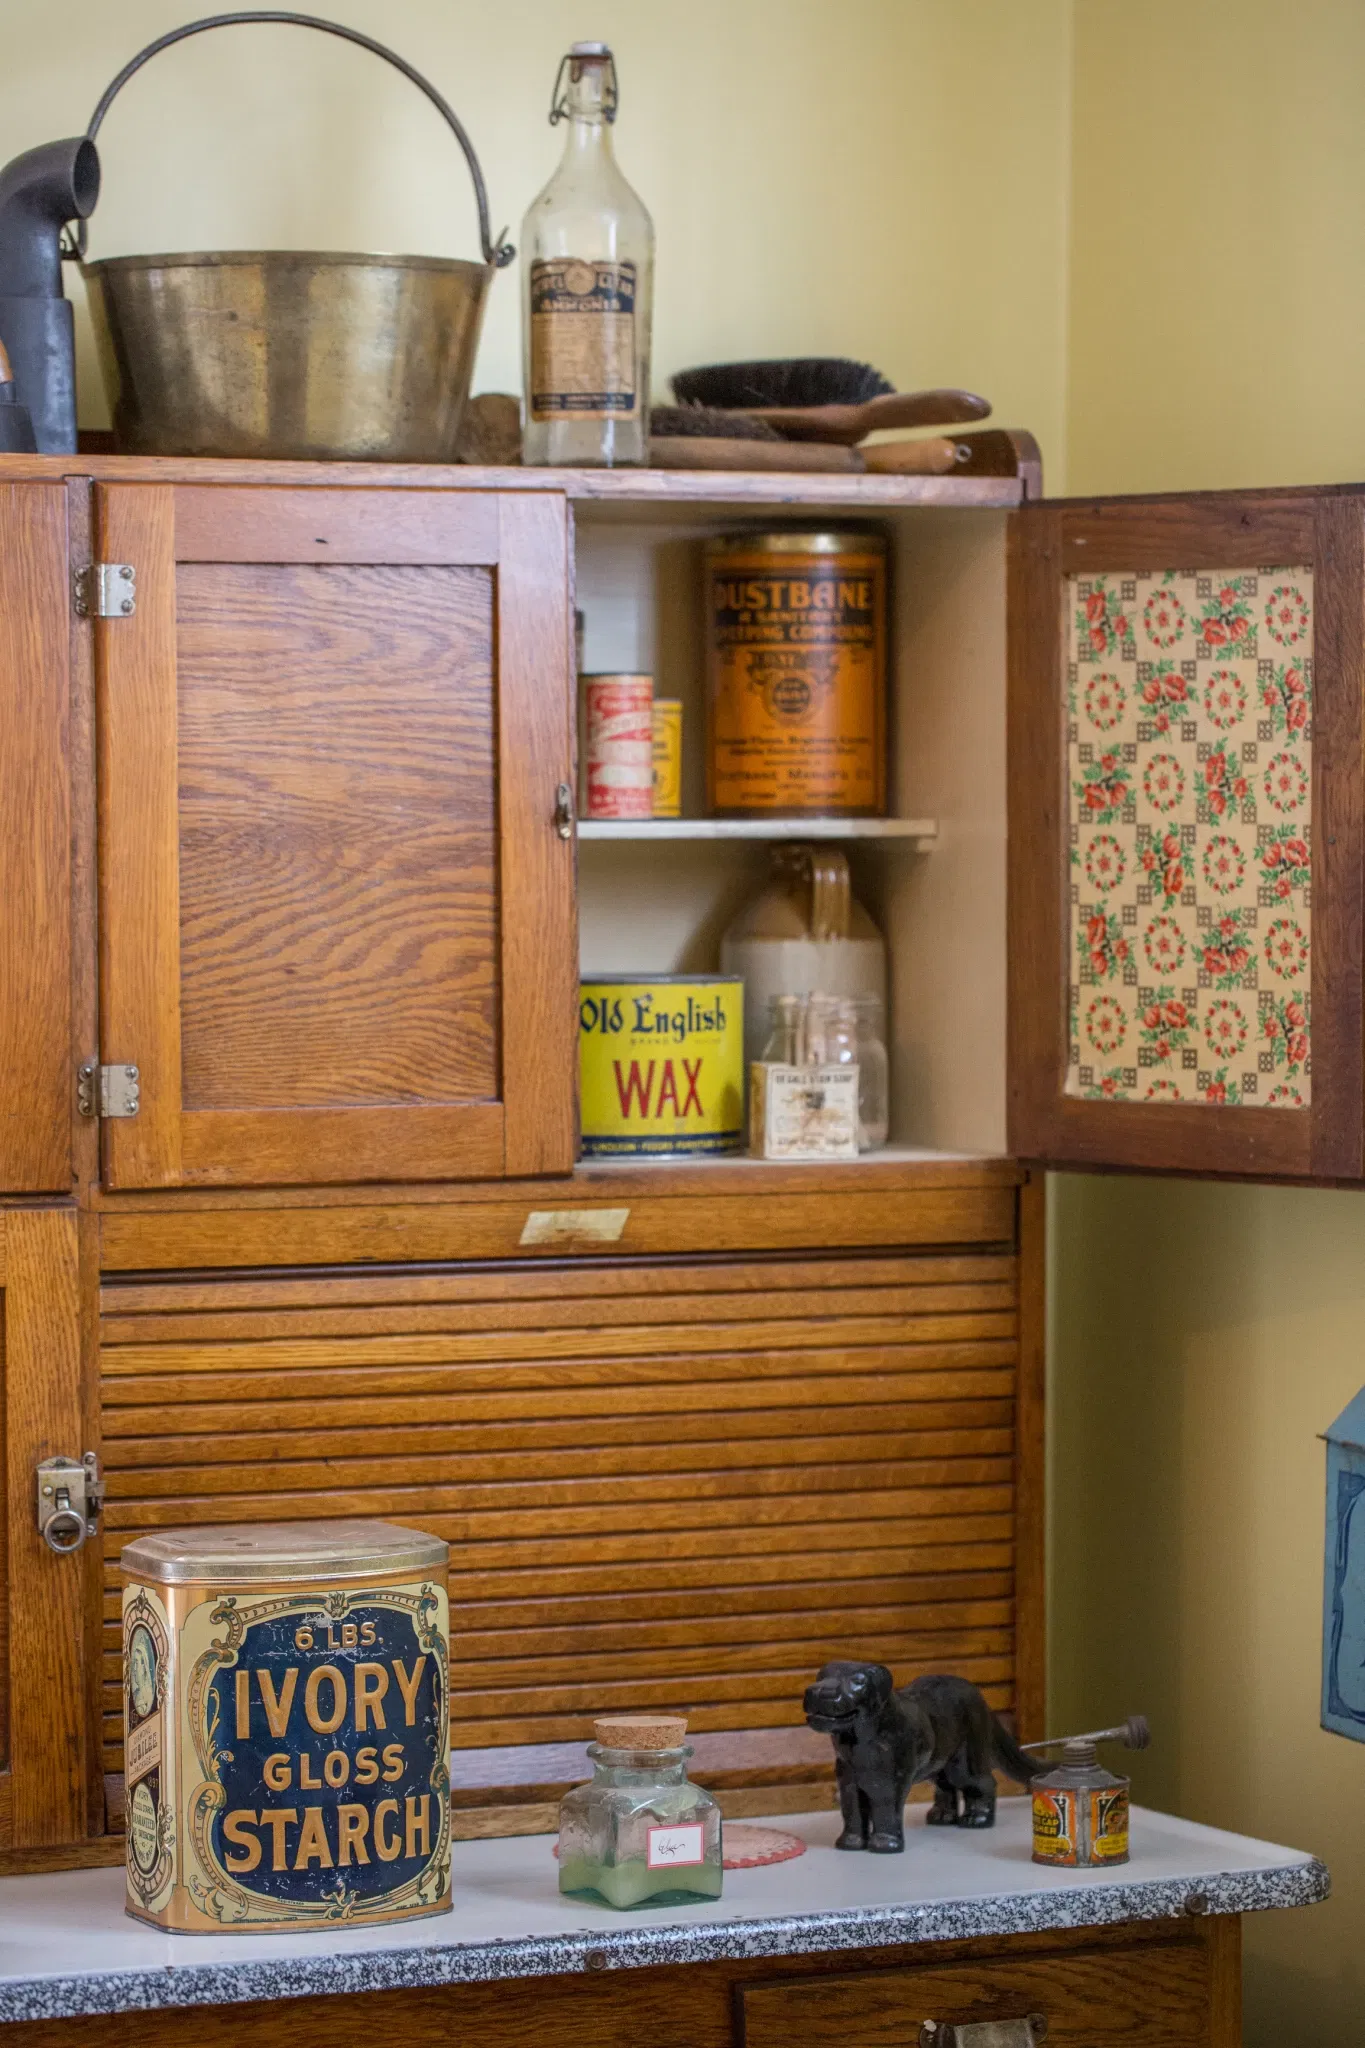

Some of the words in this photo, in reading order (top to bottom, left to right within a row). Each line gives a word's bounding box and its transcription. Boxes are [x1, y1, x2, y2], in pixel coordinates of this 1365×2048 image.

[714, 580, 871, 610] DUSTBANE
[580, 997, 624, 1033] Old
[631, 992, 727, 1043] English
[613, 1058, 705, 1119] WAX
[294, 1626, 314, 1650] 6
[327, 1621, 385, 1649] LBS.
[235, 1655, 427, 1740] IVORY
[262, 1743, 406, 1792] GLOSS
[222, 1794, 431, 1873] STARCH
